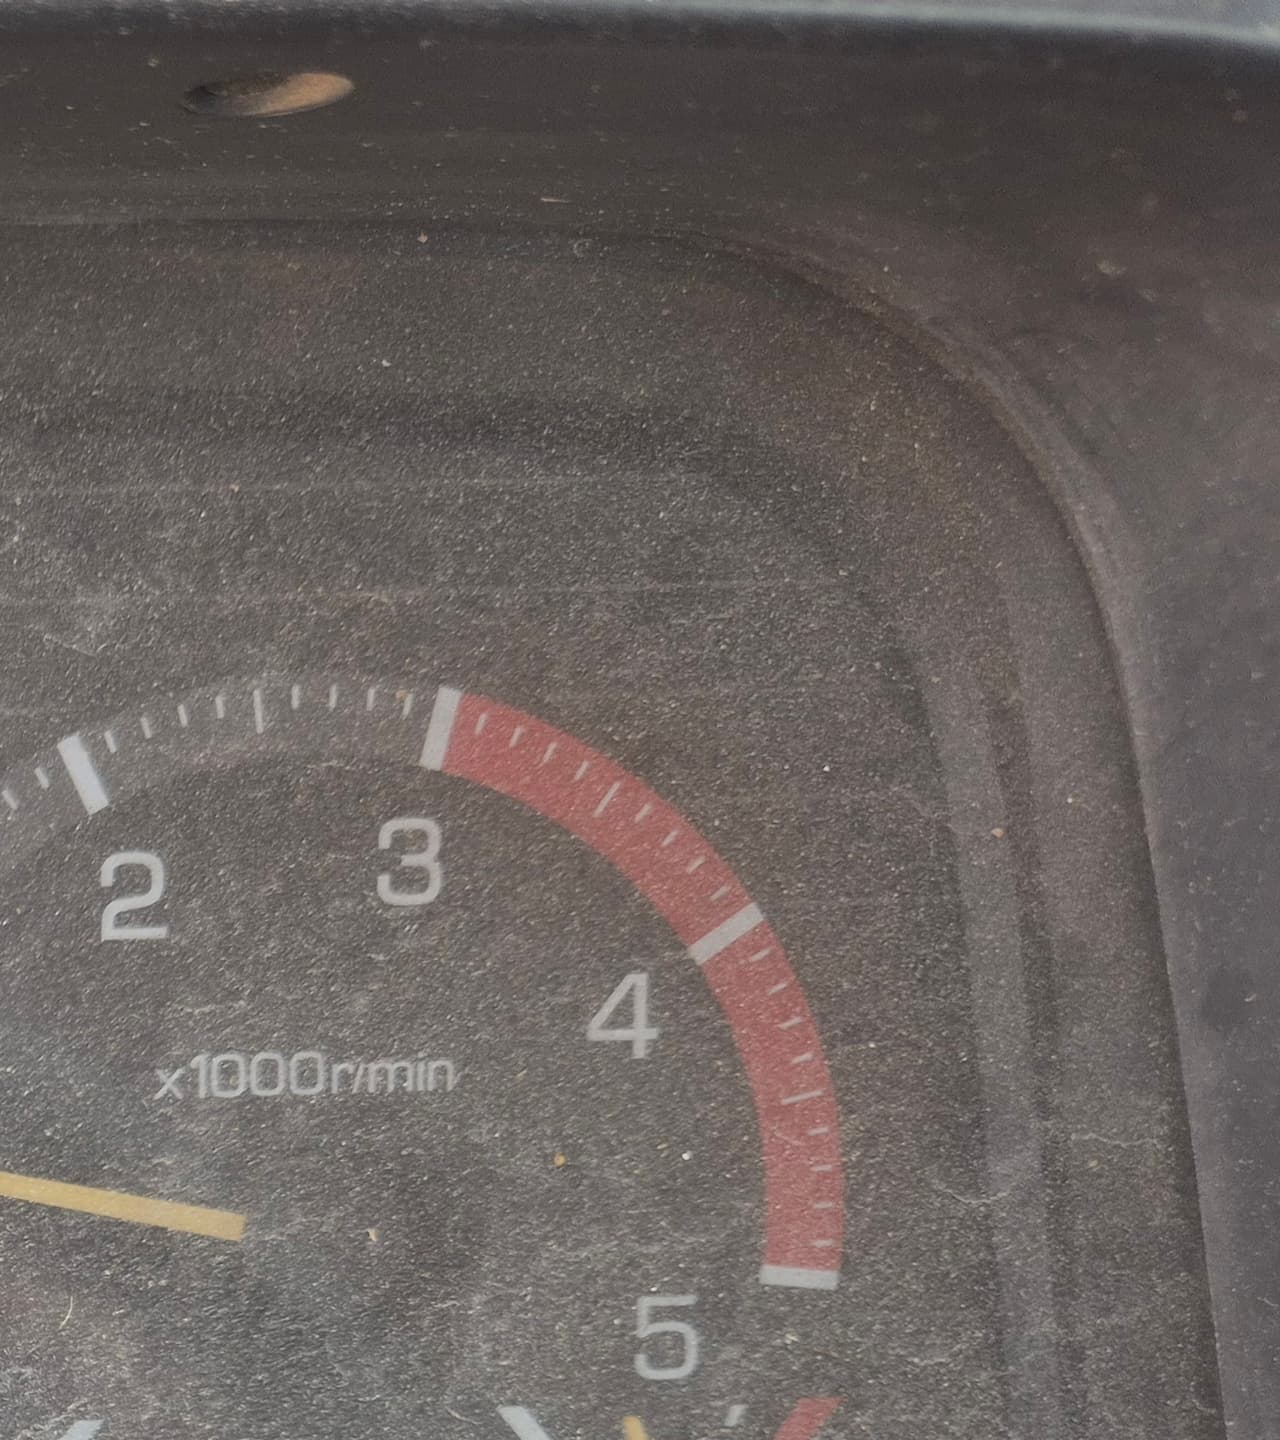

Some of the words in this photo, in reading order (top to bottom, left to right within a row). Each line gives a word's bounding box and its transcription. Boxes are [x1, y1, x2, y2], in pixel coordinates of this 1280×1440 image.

[98, 850, 169, 940] 2
[375, 817, 442, 905] 3
[585, 972, 658, 1058] 4
[633, 1296, 699, 1379] 5
